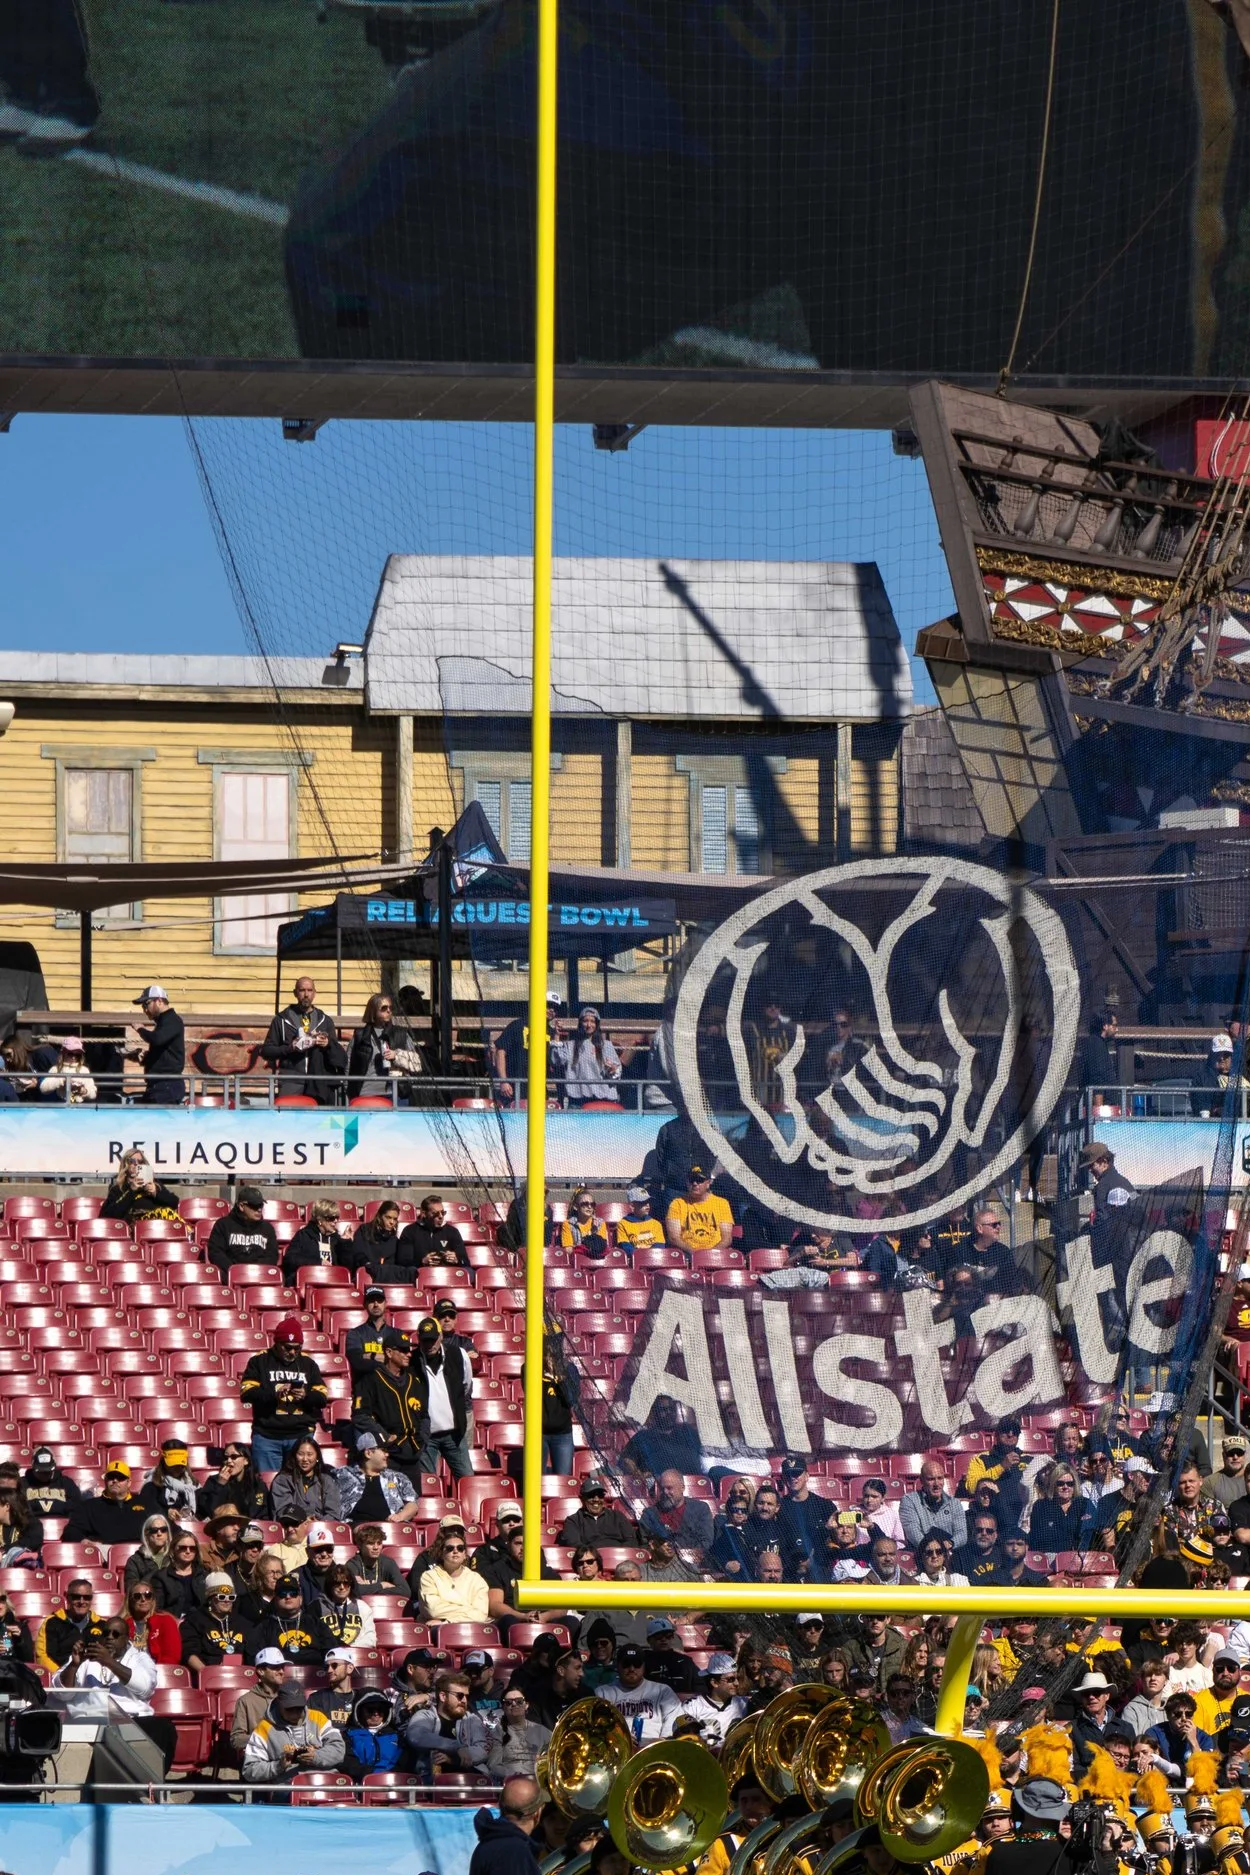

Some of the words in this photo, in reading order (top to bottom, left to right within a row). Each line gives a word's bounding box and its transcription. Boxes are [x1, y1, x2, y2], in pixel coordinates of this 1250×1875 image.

[367, 900, 553, 925] RELQUES
[560, 905, 650, 928] BOWL
[229, 1233, 268, 1250] VANDERBILT
[624, 1229, 1196, 1453] Allstate
[269, 1370, 307, 1383] IOWA
[39, 1500, 54, 1514] V
